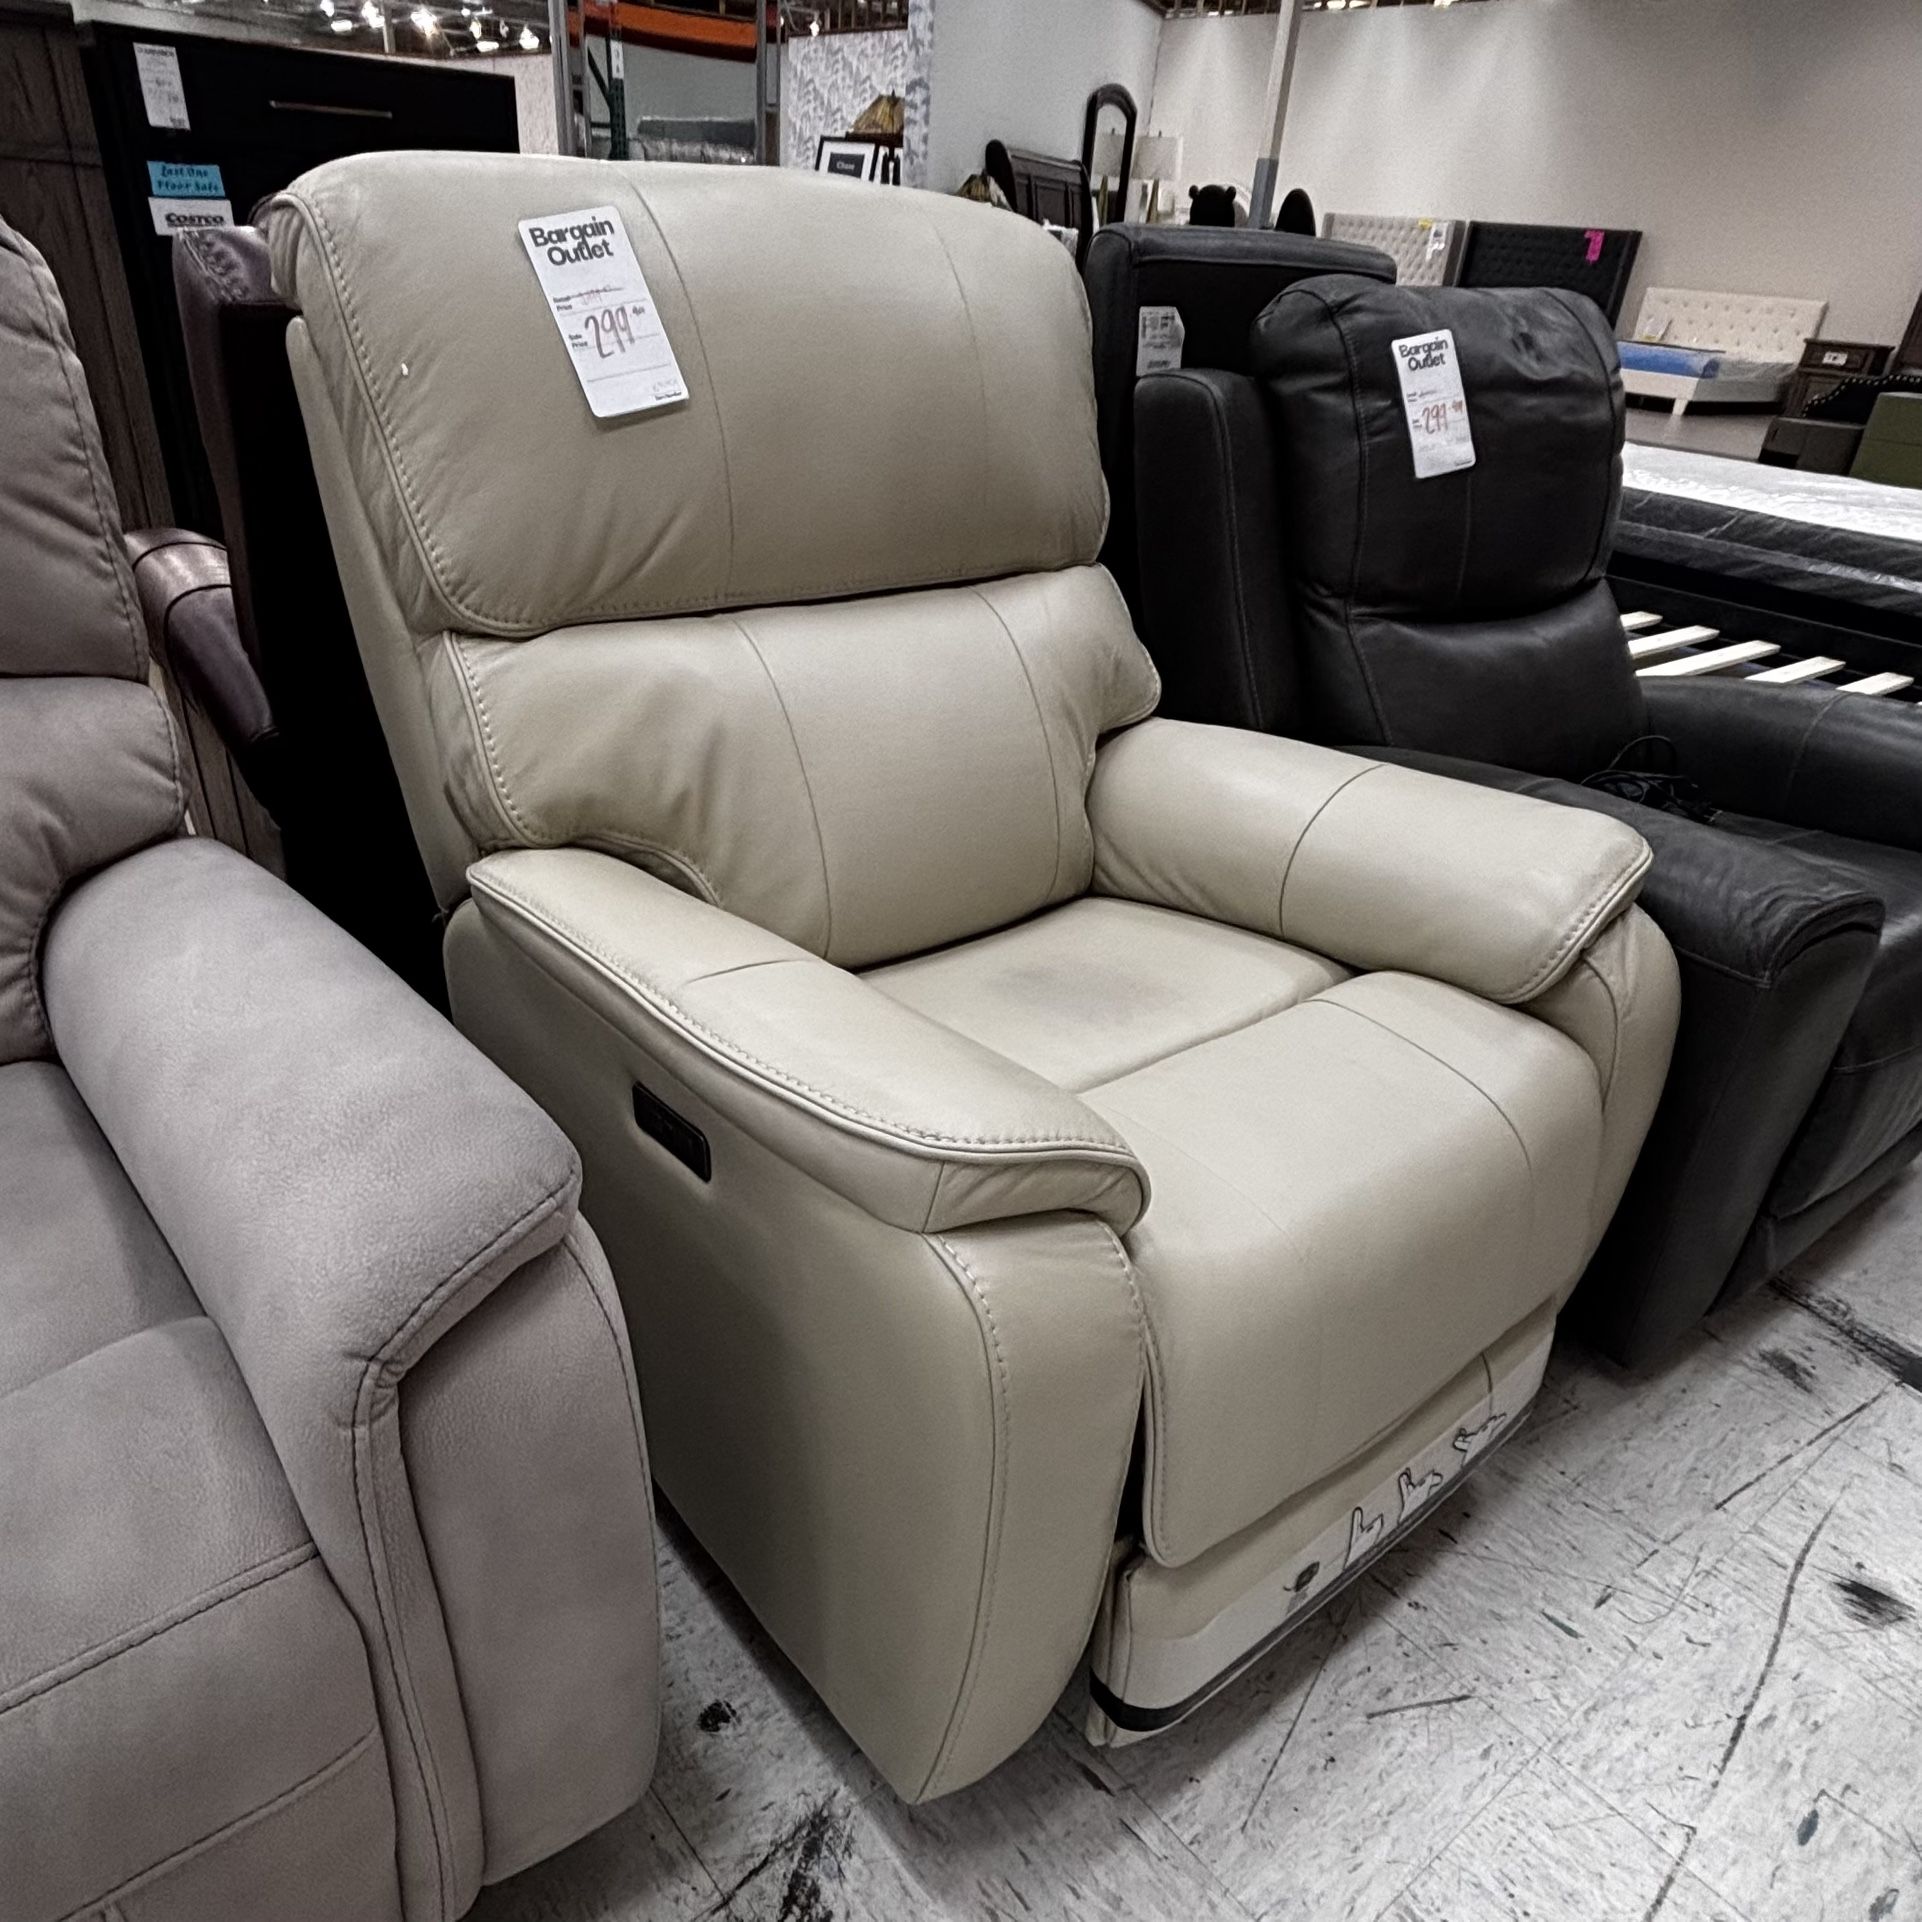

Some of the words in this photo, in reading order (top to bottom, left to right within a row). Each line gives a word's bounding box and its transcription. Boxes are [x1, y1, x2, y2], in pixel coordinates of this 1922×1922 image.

[528, 216, 614, 248] Bargain
[547, 239, 614, 267] Outlet
[1399, 336, 1448, 358] Bargain
[1408, 353, 1446, 371] Outlet
